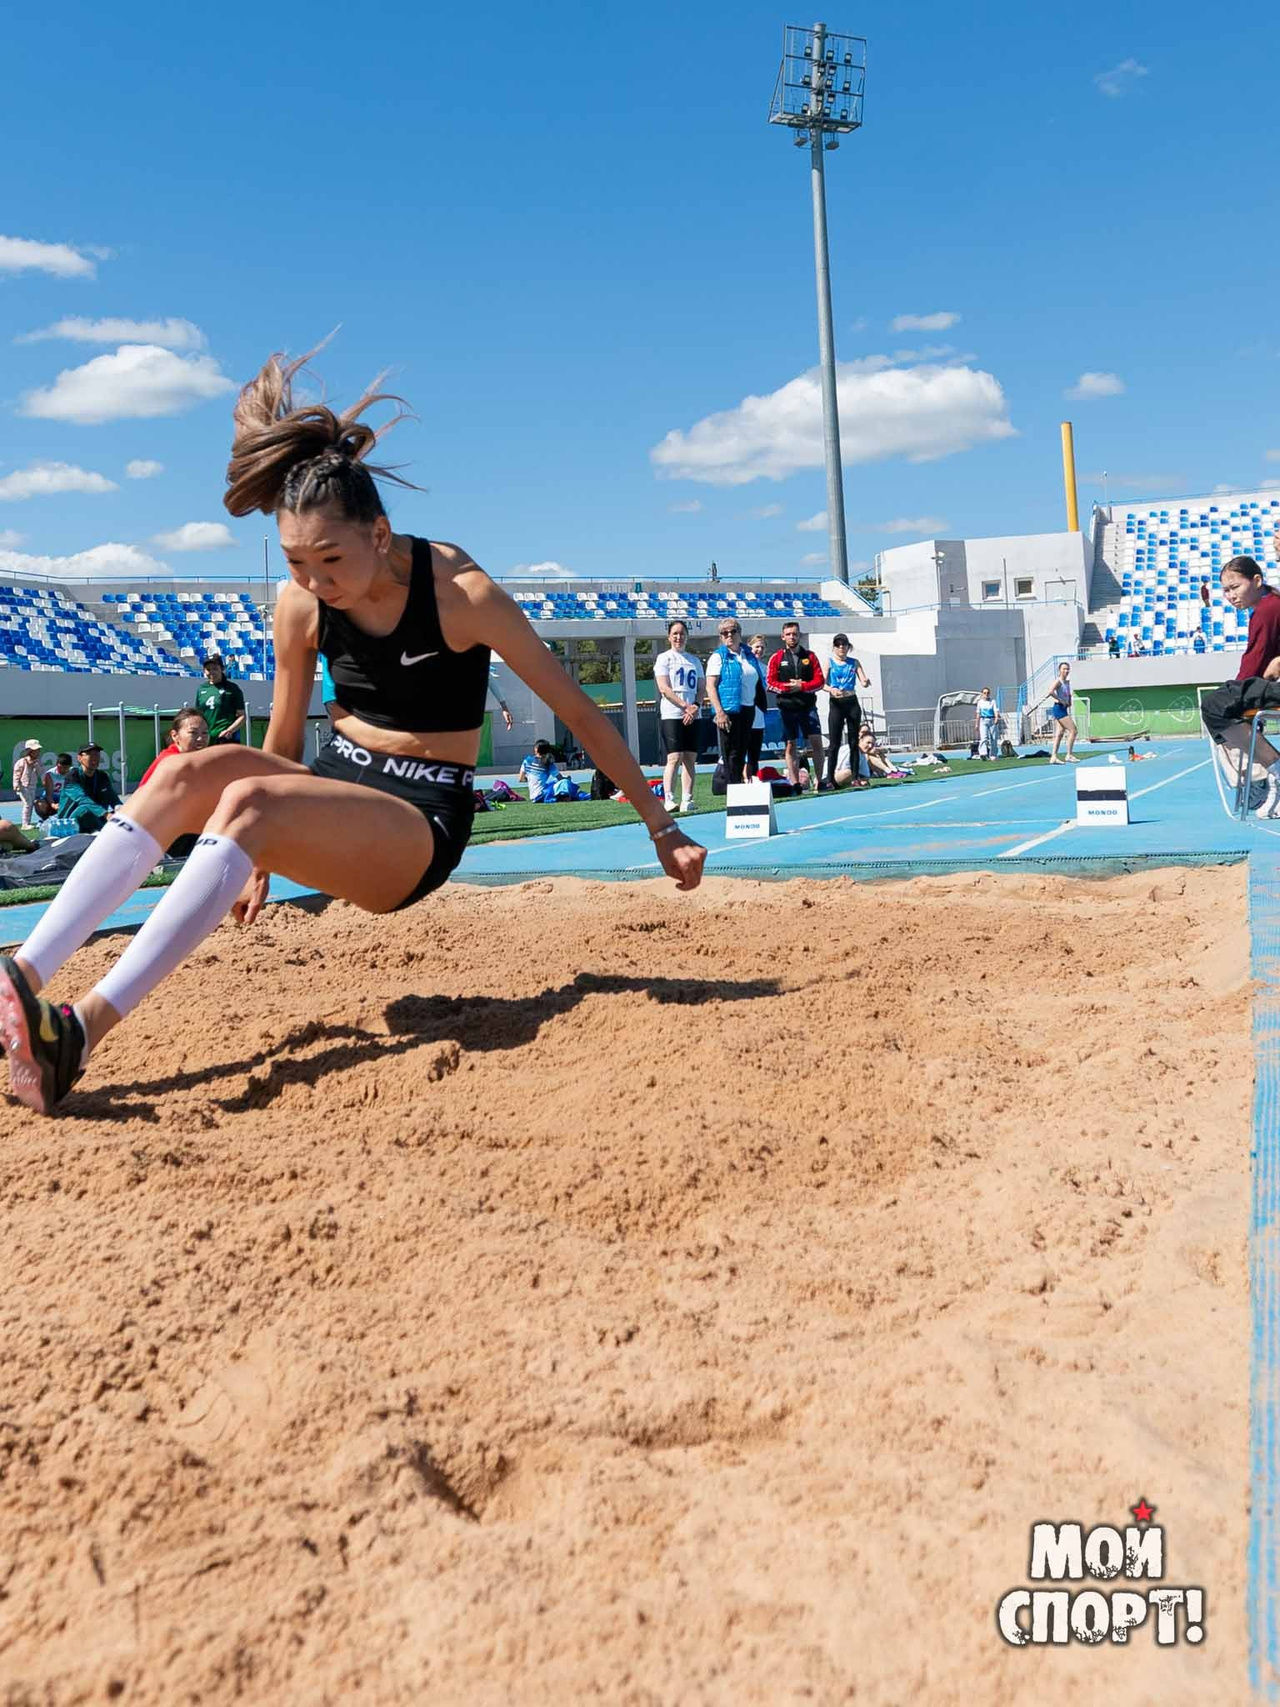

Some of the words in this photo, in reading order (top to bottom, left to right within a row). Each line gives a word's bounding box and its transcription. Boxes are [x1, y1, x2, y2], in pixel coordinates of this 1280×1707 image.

[675, 666, 697, 689] 16
[205, 695, 215, 710] 4
[330, 735, 372, 766] PRO
[383, 758, 459, 785] NIKE
